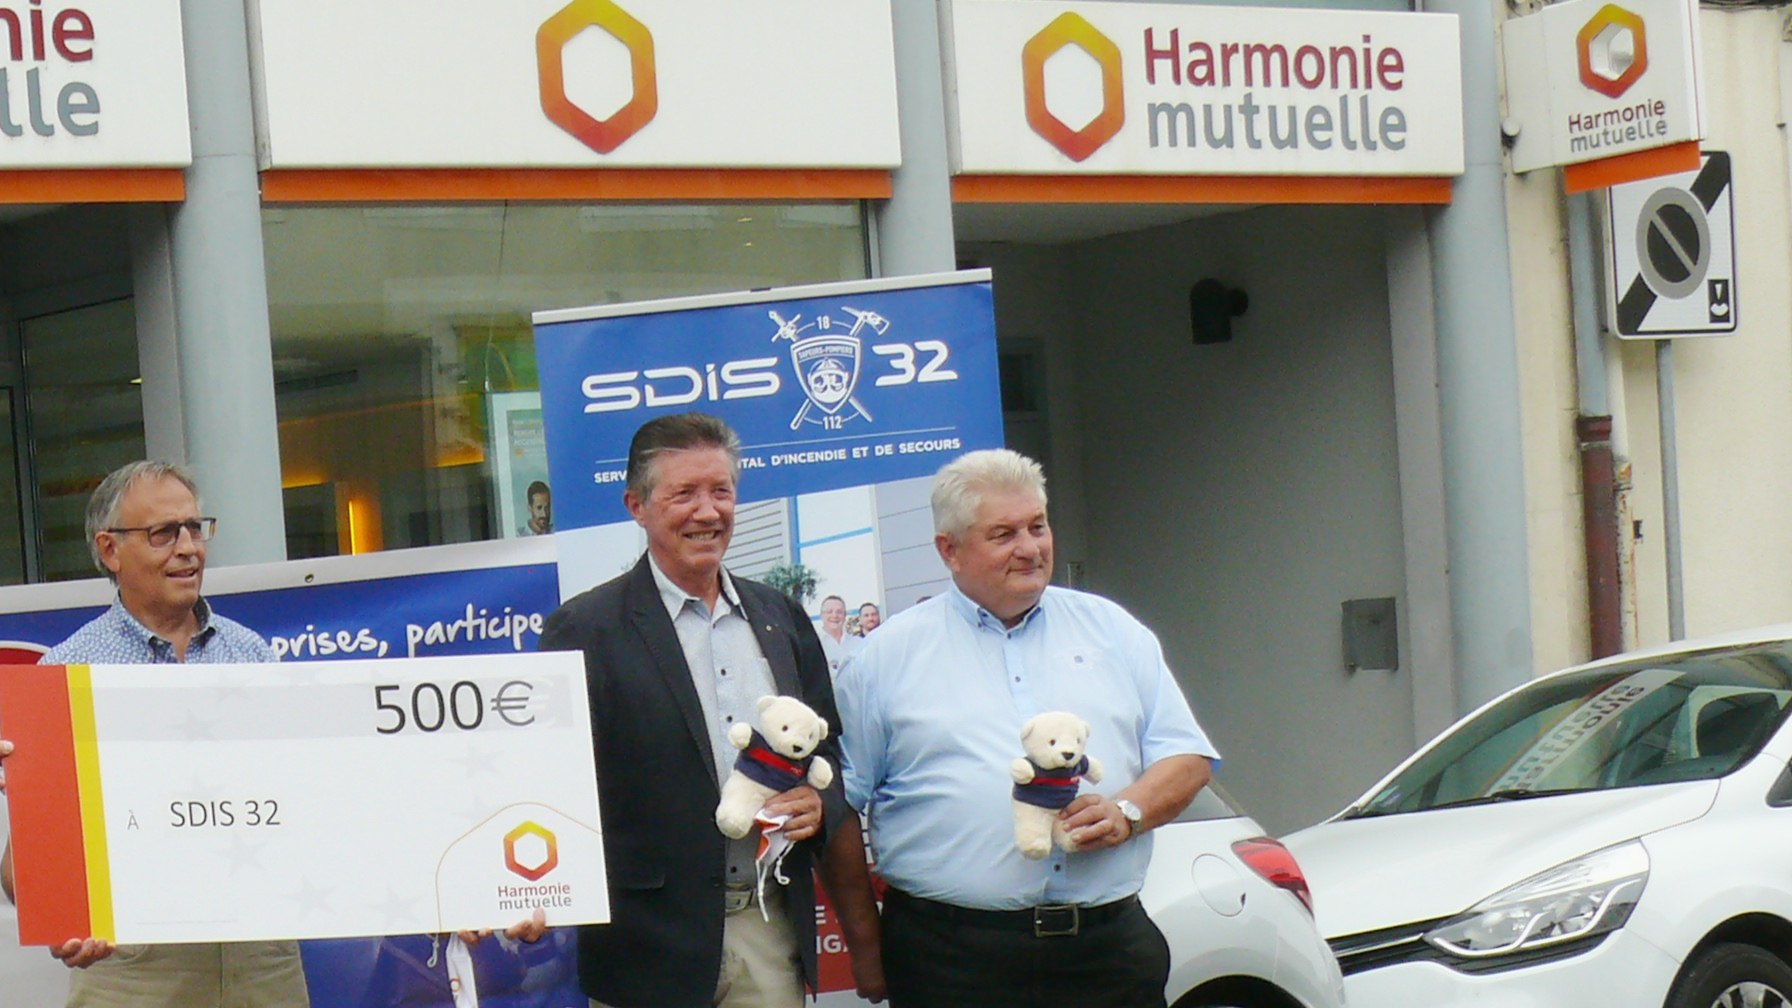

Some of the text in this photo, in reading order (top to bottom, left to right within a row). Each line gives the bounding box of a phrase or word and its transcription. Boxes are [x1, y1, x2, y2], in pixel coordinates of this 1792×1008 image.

[1143, 27, 1405, 91] Harmonie
[1147, 92, 1407, 151] mutuelle
[1568, 98, 1666, 134] Harmonie
[1570, 118, 1668, 153] mutuelle
[816, 315, 830, 330] 18
[871, 340, 958, 387] 32
[823, 416, 843, 430] 112
[771, 448, 847, 467] D'INCENDIE
[852, 446, 869, 459] ET
[875, 443, 893, 457] DE
[898, 438, 961, 455] SECOURS
[170, 800, 235, 827] SDIS
[244, 799, 281, 826] 32
[498, 883, 571, 897] Harmonie
[499, 896, 572, 911] mutuelle
